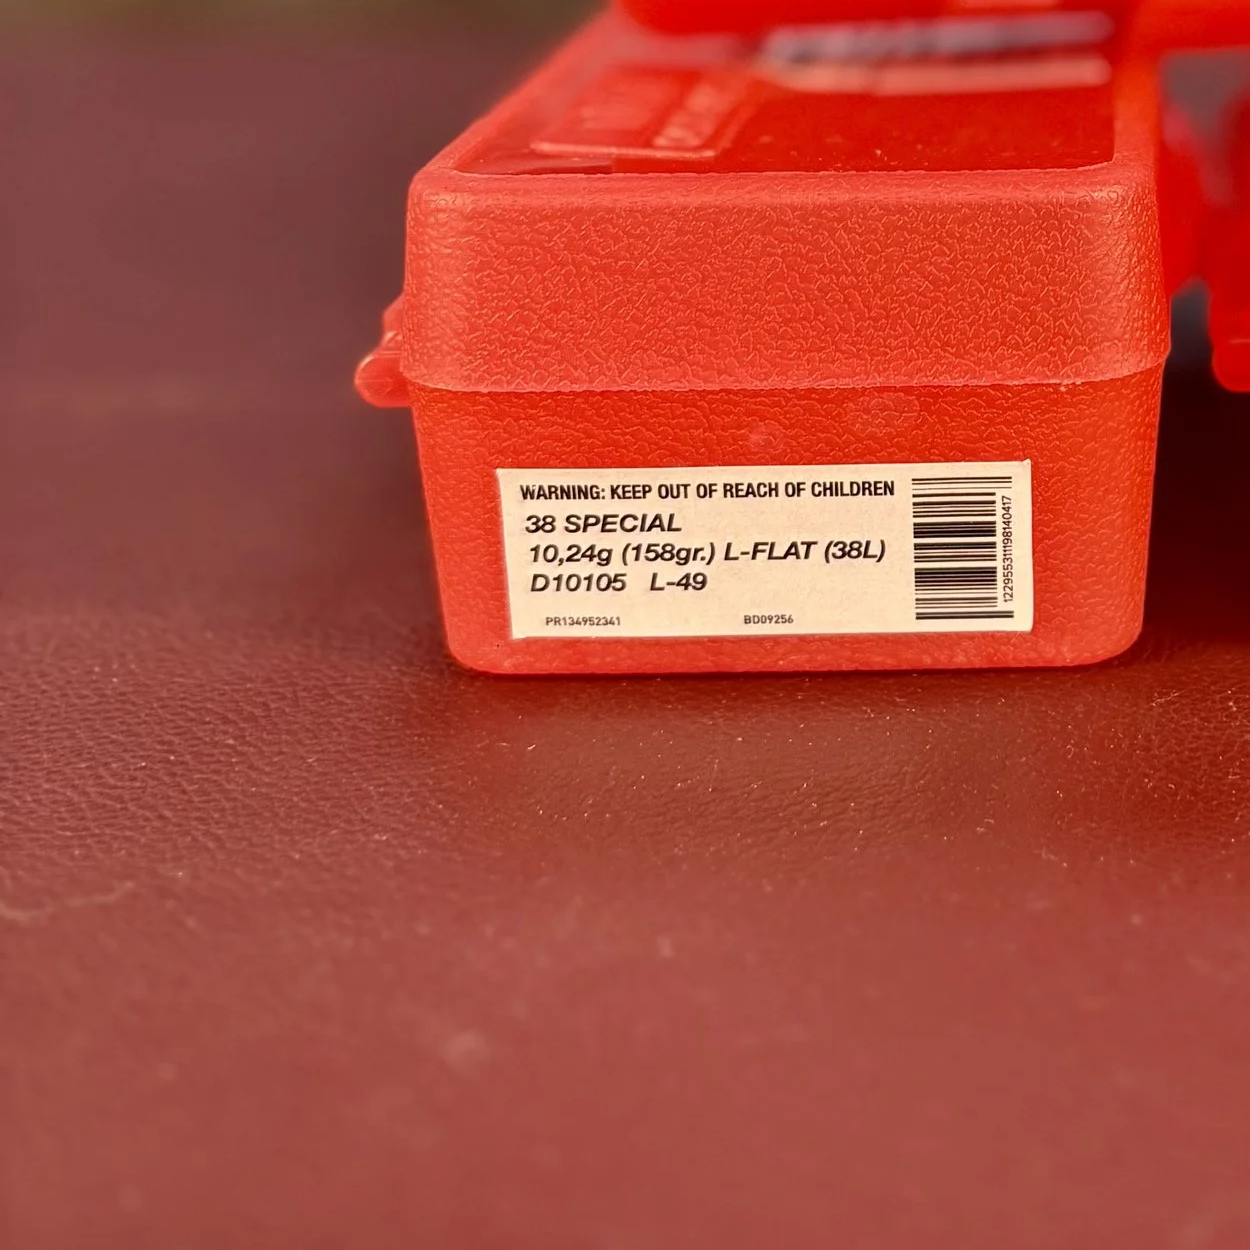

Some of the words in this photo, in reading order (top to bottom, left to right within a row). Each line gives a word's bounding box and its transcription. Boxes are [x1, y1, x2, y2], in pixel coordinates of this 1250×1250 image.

[520, 485, 605, 500] WARNING:
[610, 485, 652, 499] KEEP
[658, 484, 691, 499] OUT
[696, 483, 717, 498] OF
[723, 482, 778, 498] REACH
[785, 482, 806, 497] OF
[811, 481, 894, 497] CHILDREN
[526, 515, 556, 533] 38
[564, 513, 682, 533] SPECIAL
[530, 544, 613, 566] 10,24g
[622, 542, 715, 566] (158gr.)
[724, 541, 818, 561] L-FLAT
[825, 540, 885, 563] (38L)
[1002, 495, 1014, 603] 122955311198140417
[531, 573, 626, 592] D10105
[650, 573, 707, 591] L-49
[545, 616, 621, 627] PR134952341
[743, 614, 794, 625] BD09256
